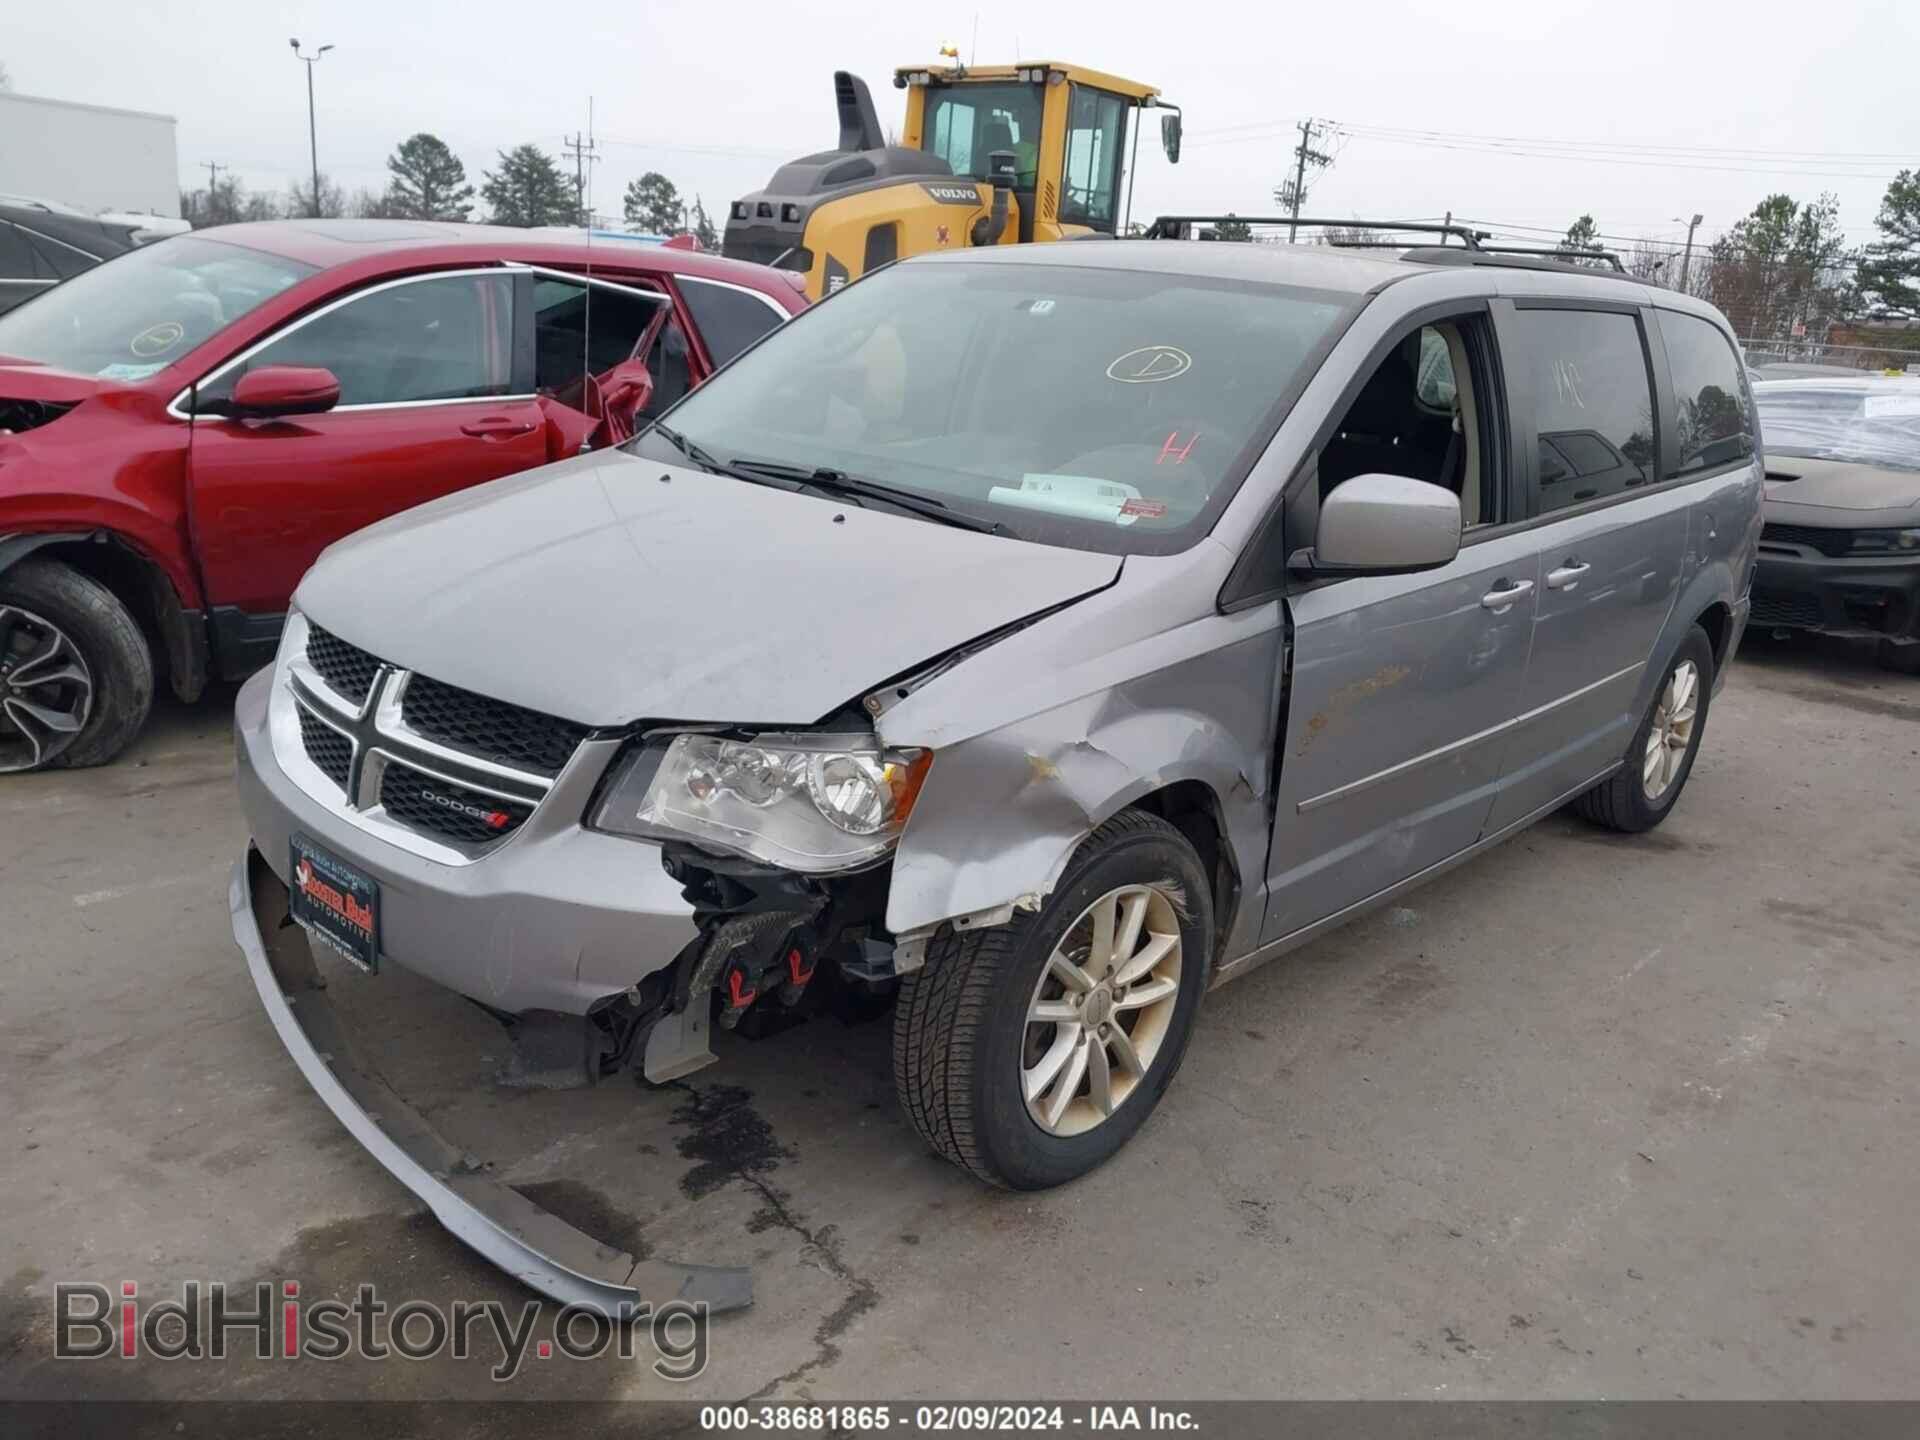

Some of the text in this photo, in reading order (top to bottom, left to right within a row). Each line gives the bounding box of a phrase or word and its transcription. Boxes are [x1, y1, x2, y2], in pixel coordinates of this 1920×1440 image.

[929, 187, 977, 200] VOLVO
[1155, 431, 1201, 465] H
[422, 790, 493, 821] DODGE
[306, 894, 371, 943] AUTOMOTIVE
